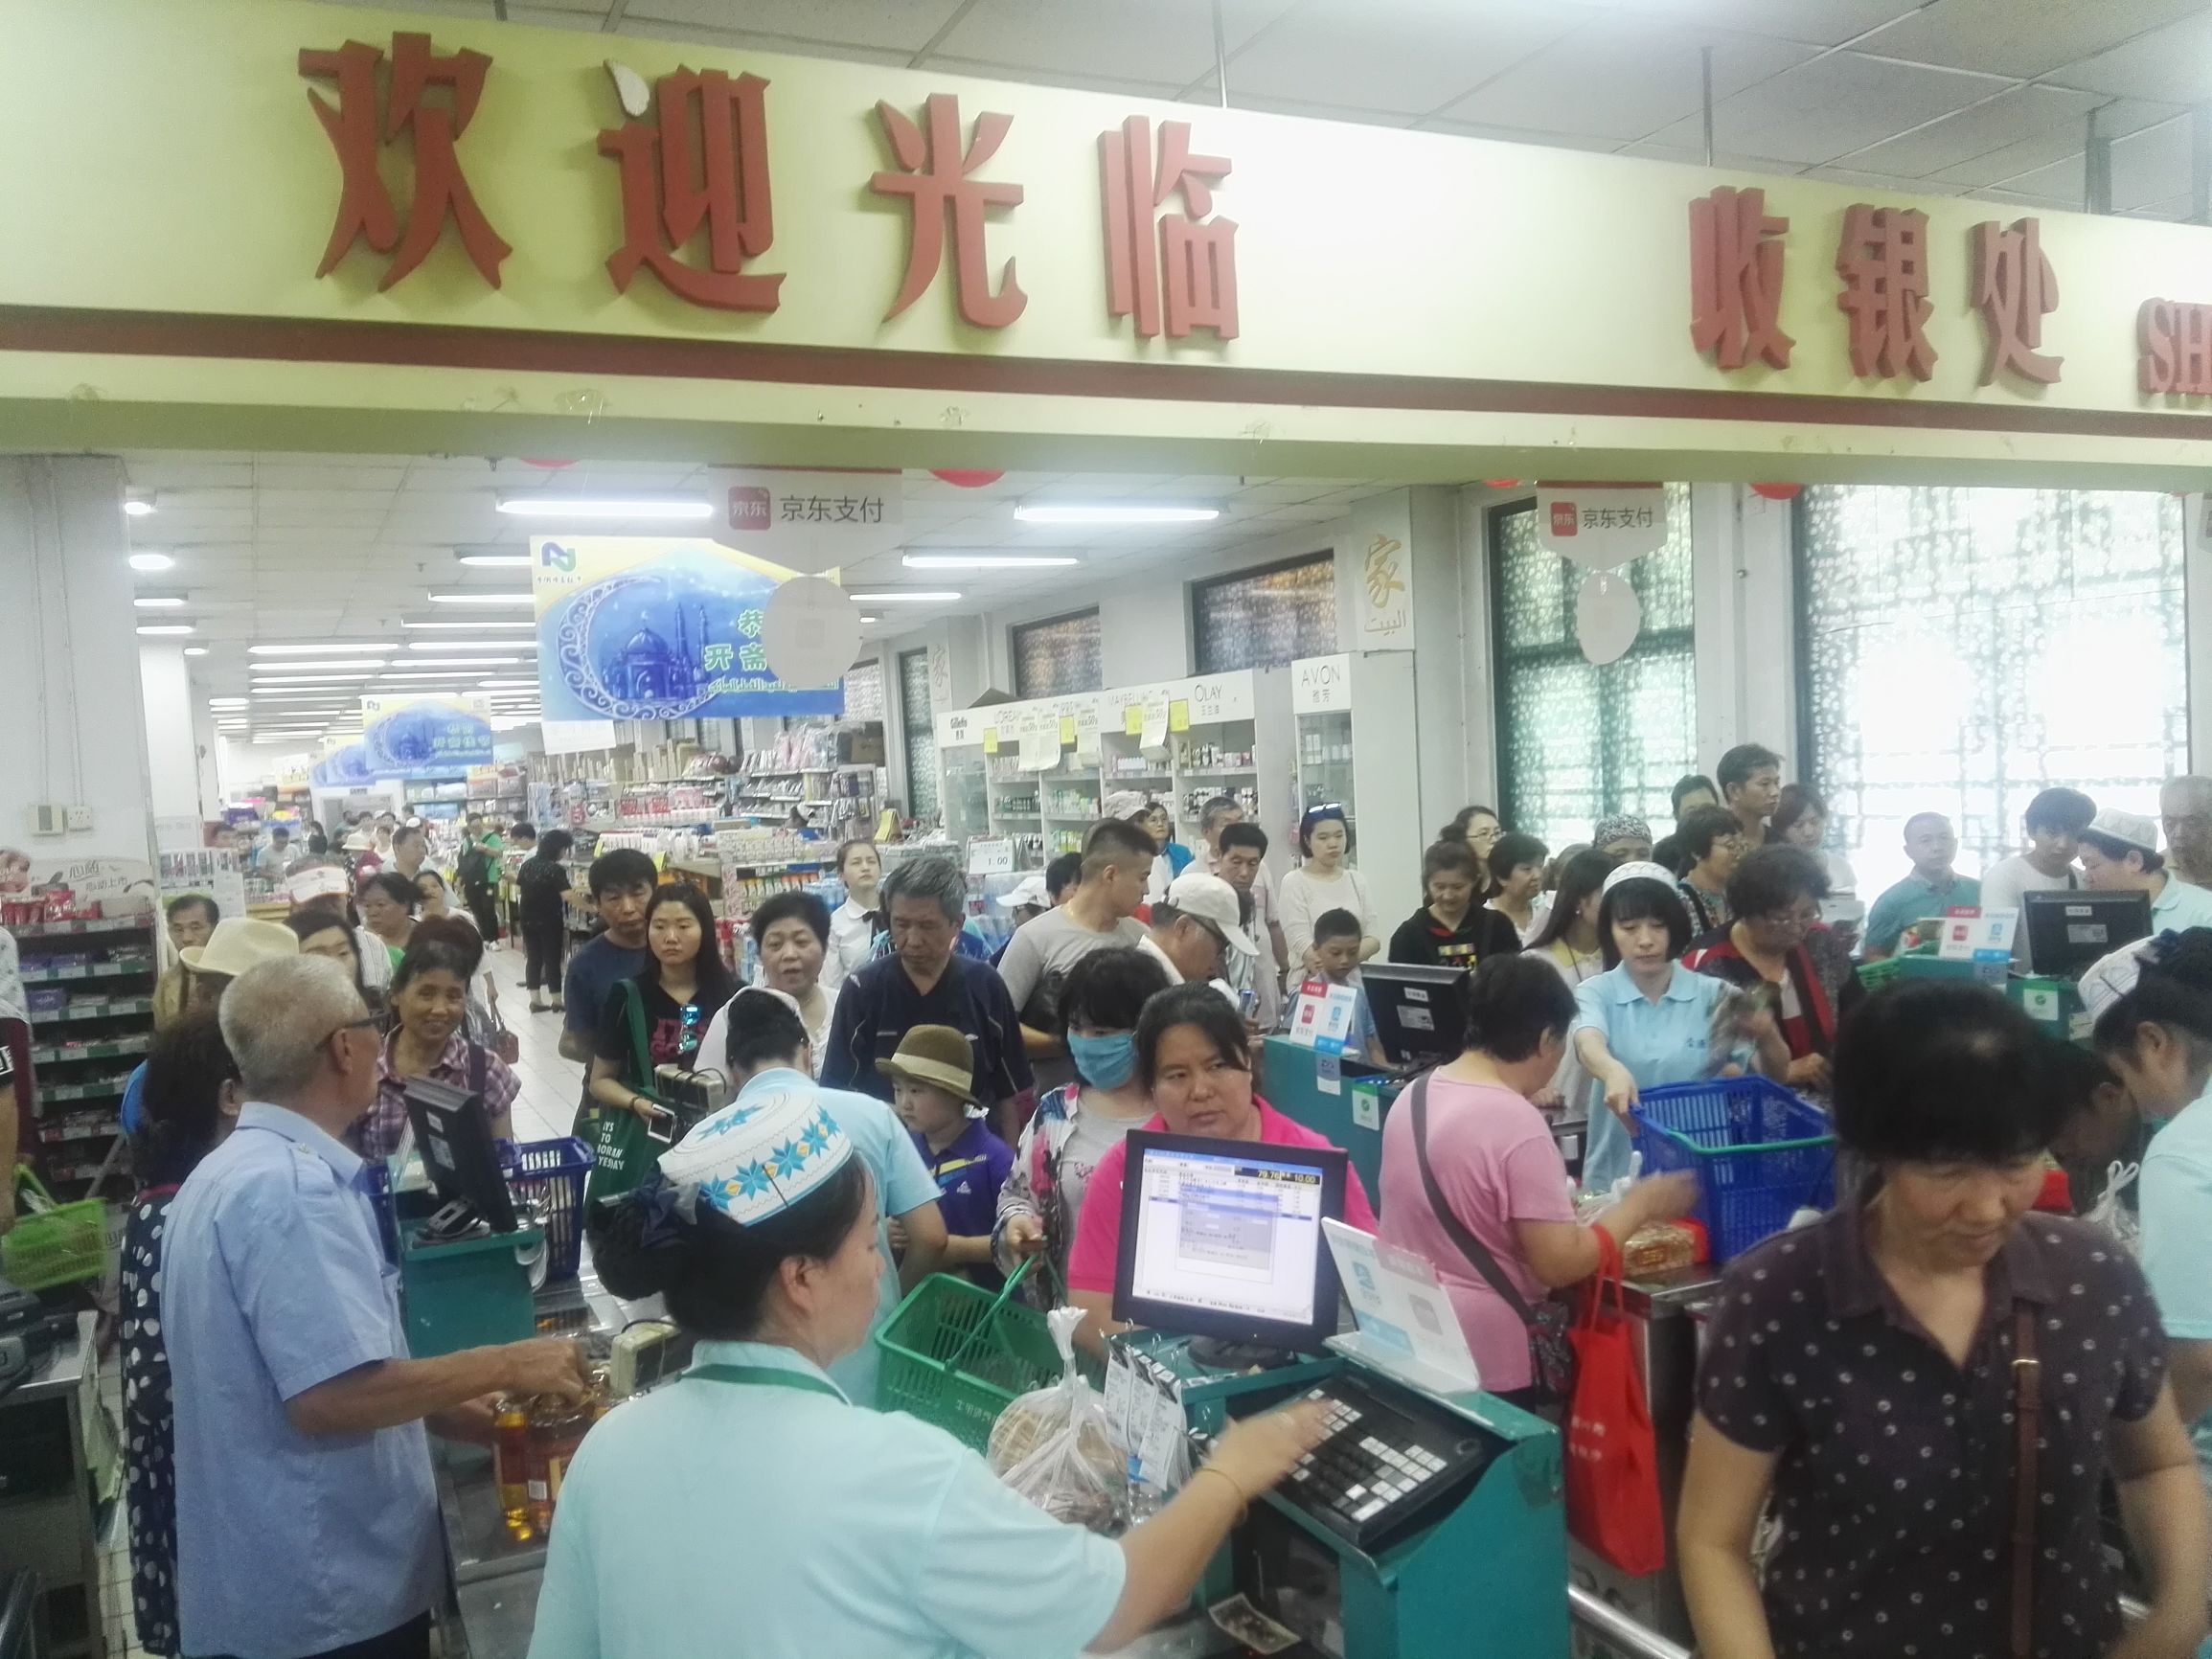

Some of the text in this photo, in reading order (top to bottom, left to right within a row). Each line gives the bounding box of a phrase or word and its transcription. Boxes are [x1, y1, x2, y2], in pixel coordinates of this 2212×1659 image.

[298, 32, 1239, 341] 欢迎光临
[1689, 186, 2064, 386] 收银处
[780, 495, 884, 523] 京东支付
[1582, 507, 1653, 529] 京东支付
[1364, 534, 1406, 608] 家
[1302, 666, 1340, 687] AVON
